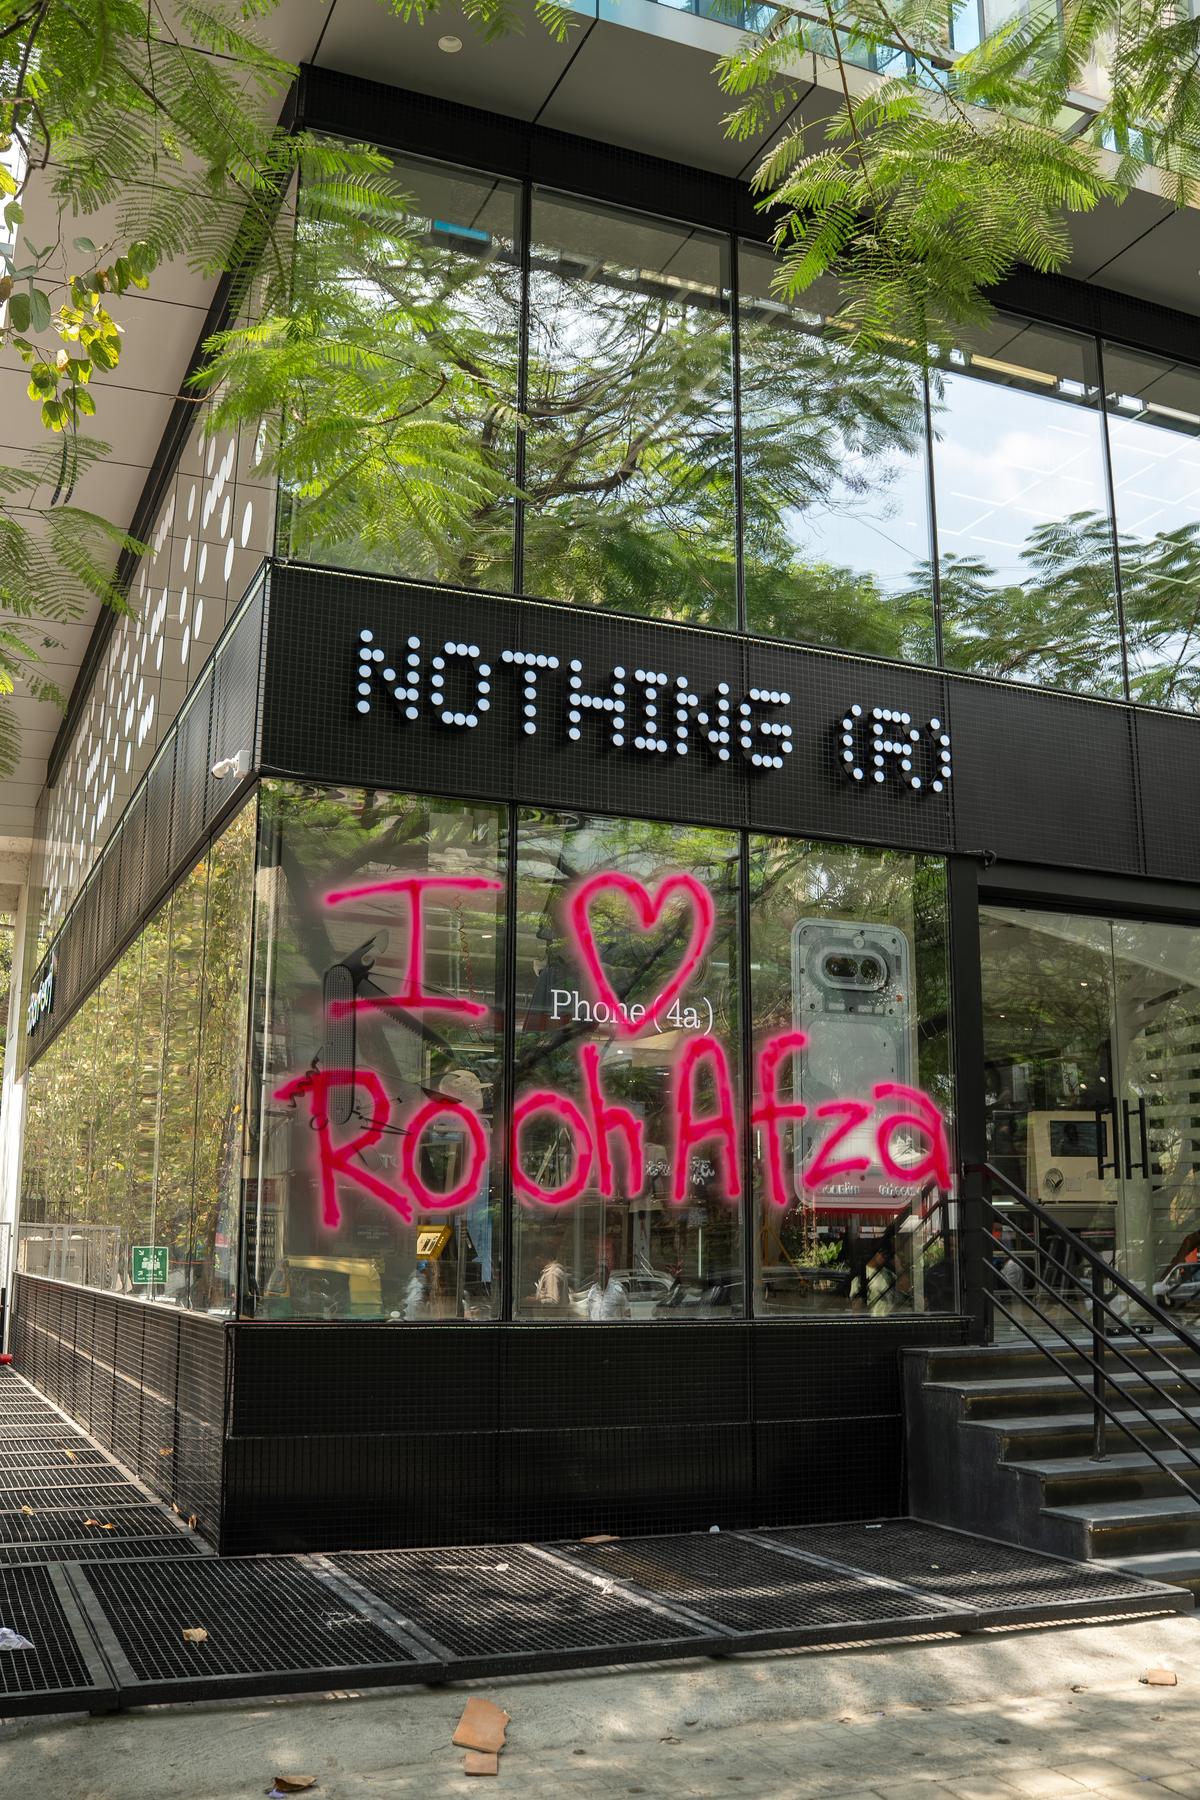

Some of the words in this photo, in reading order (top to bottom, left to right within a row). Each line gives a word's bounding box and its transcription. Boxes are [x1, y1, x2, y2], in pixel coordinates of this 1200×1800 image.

[357, 628, 793, 769] NOTHING
[841, 703, 952, 793] (R)
[323, 876, 503, 1018] I
[550, 988, 646, 1025] Phone
[652, 993, 714, 1036] (4a)
